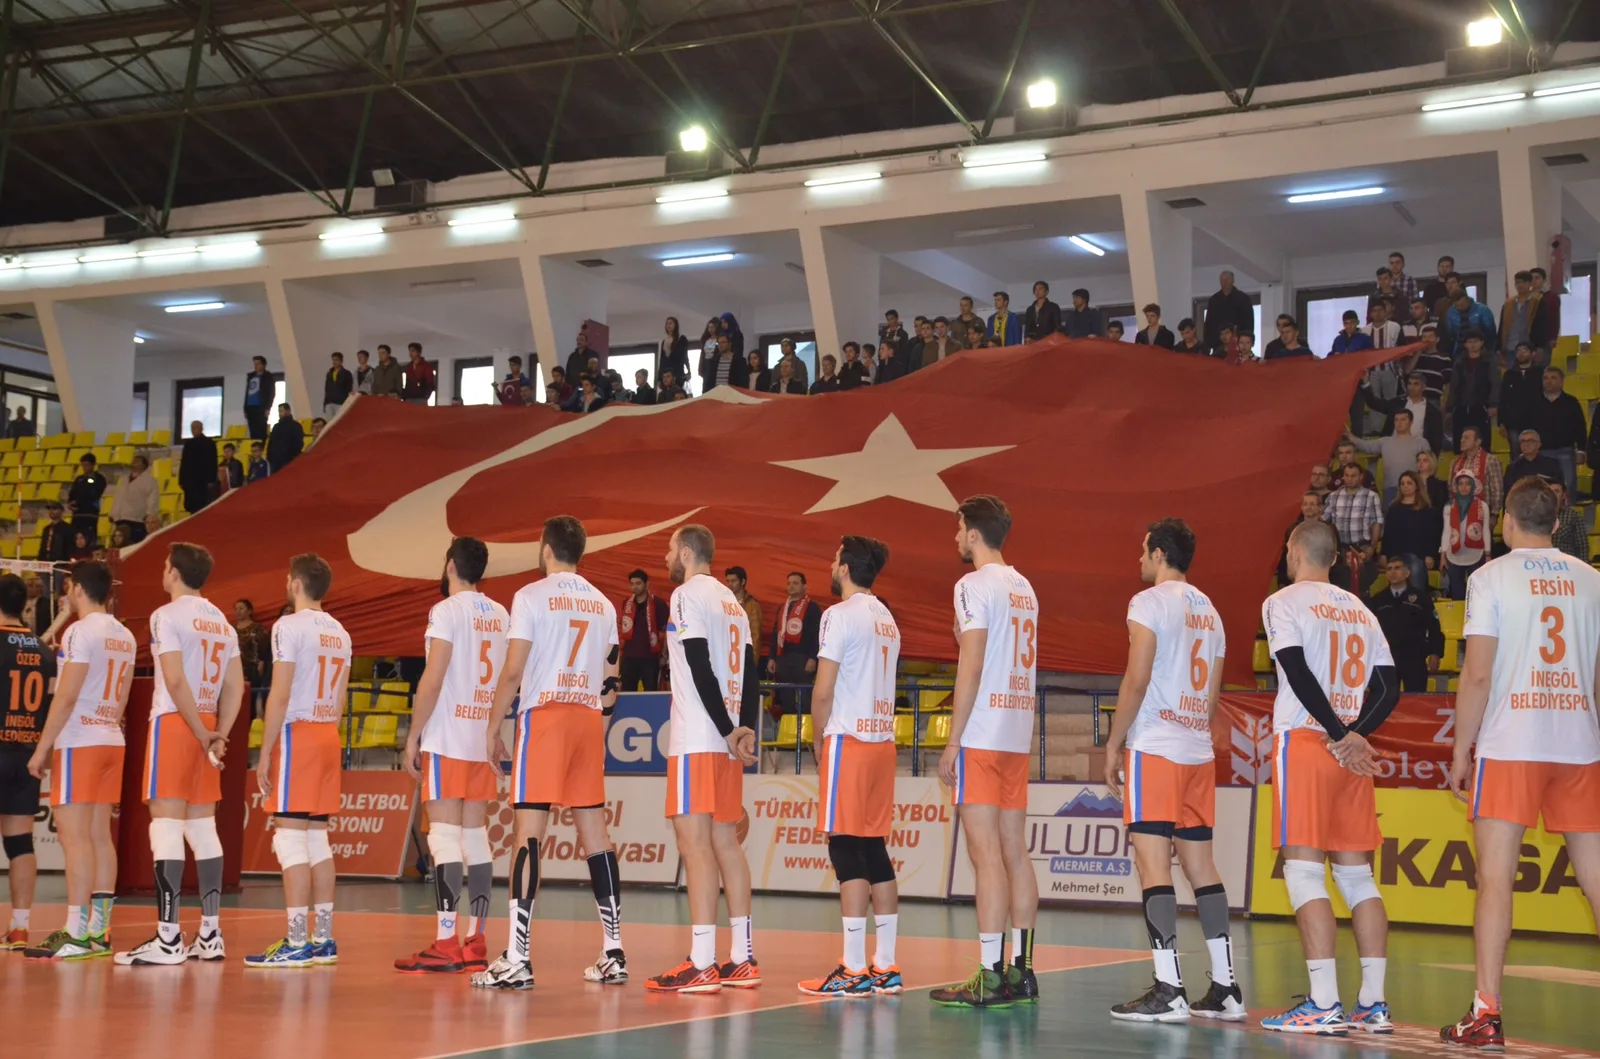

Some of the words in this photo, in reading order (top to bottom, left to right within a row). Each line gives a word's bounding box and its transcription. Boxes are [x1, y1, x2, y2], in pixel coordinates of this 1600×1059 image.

[548, 593, 573, 611] EMİN
[575, 598, 605, 616] YOLVER
[1530, 576, 1575, 596] ERSİN
[567, 618, 590, 667] 7
[728, 623, 741, 675] 8
[1011, 616, 1035, 670] 13
[1539, 606, 1566, 664] 3
[16, 650, 42, 667] ÖZER
[102, 658, 128, 703] 16
[201, 638, 226, 685] 15
[317, 655, 346, 700] 17
[479, 639, 494, 685] 5
[557, 668, 589, 690] İNEGÖL
[1189, 638, 1209, 692] 6
[1329, 630, 1366, 689] 18
[1531, 666, 1579, 689] İNEGÖL
[9, 669, 44, 713] 10
[1511, 689, 1590, 712] BELEDİYESPO
[1051, 881, 1100, 894] Mehmet
[1102, 883, 1125, 895] Şen
[1053, 859, 1103, 873] MERMER
[1106, 863, 1130, 876] A.Ş.
